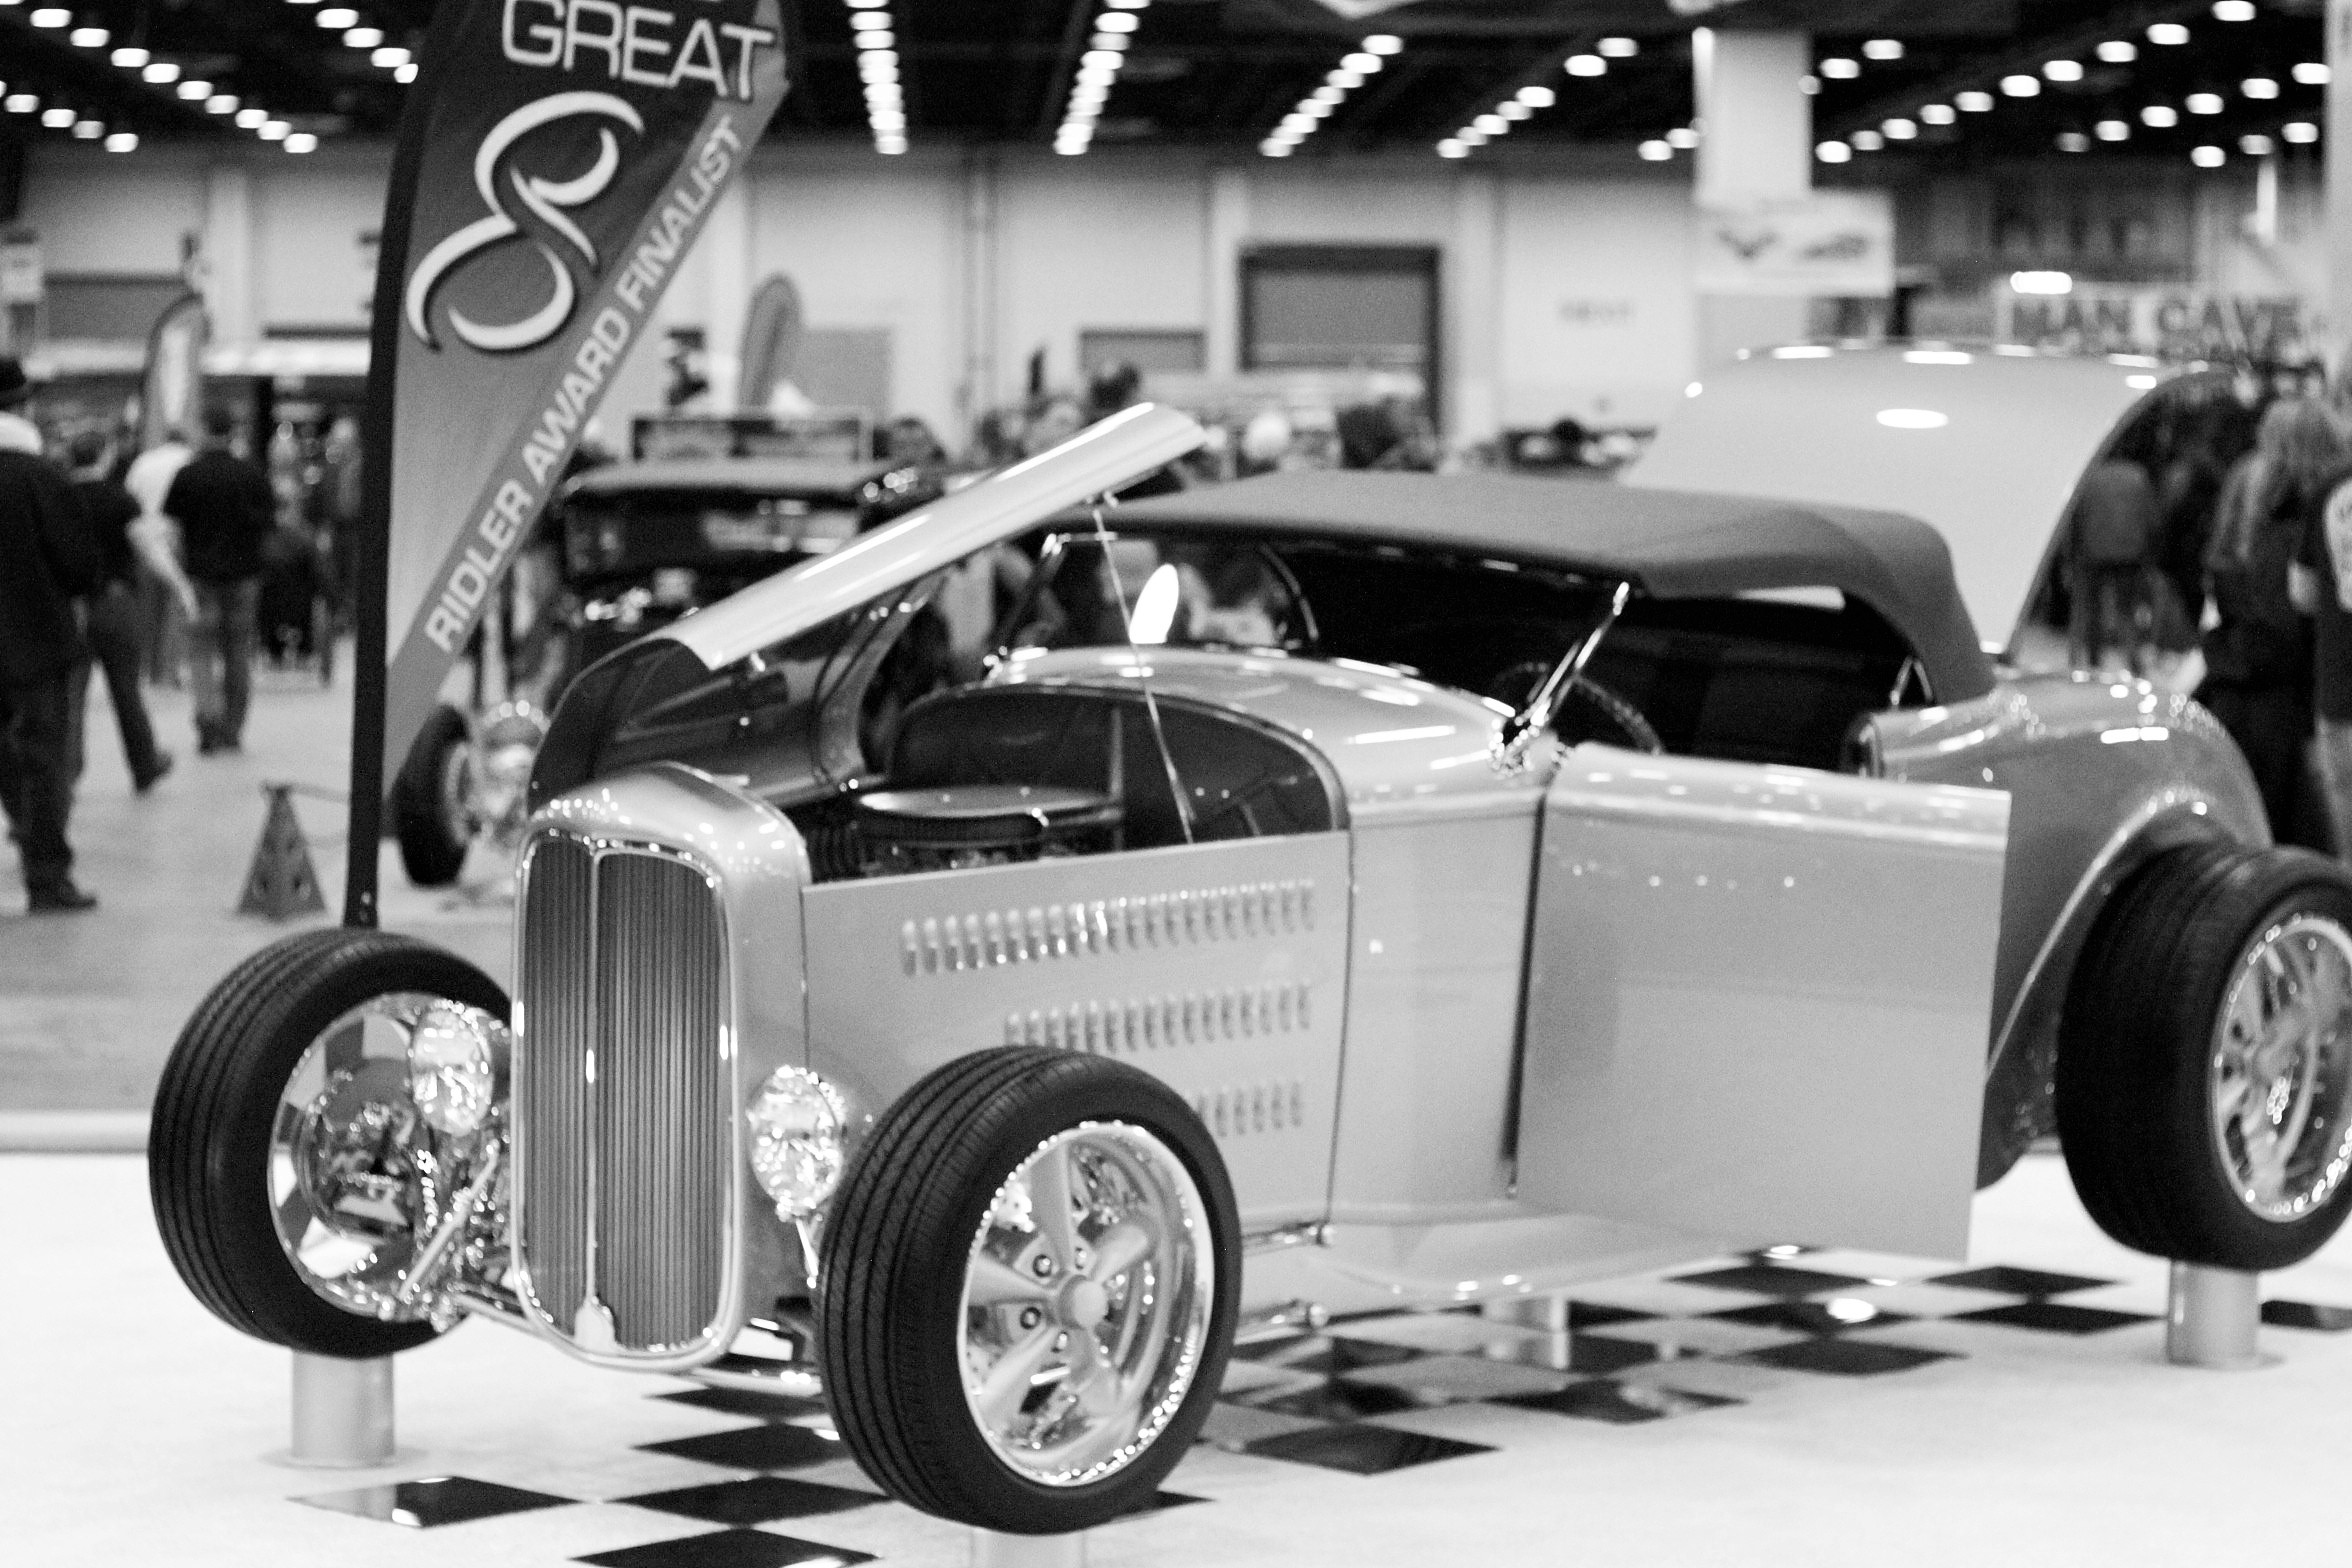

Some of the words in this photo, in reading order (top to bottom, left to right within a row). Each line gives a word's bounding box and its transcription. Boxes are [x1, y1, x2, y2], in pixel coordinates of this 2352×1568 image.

[502, 0, 774, 99] GREAT
[424, 479, 533, 652] RIDLER
[522, 307, 630, 486] AWARD
[615, 115, 741, 312] FINALIST
